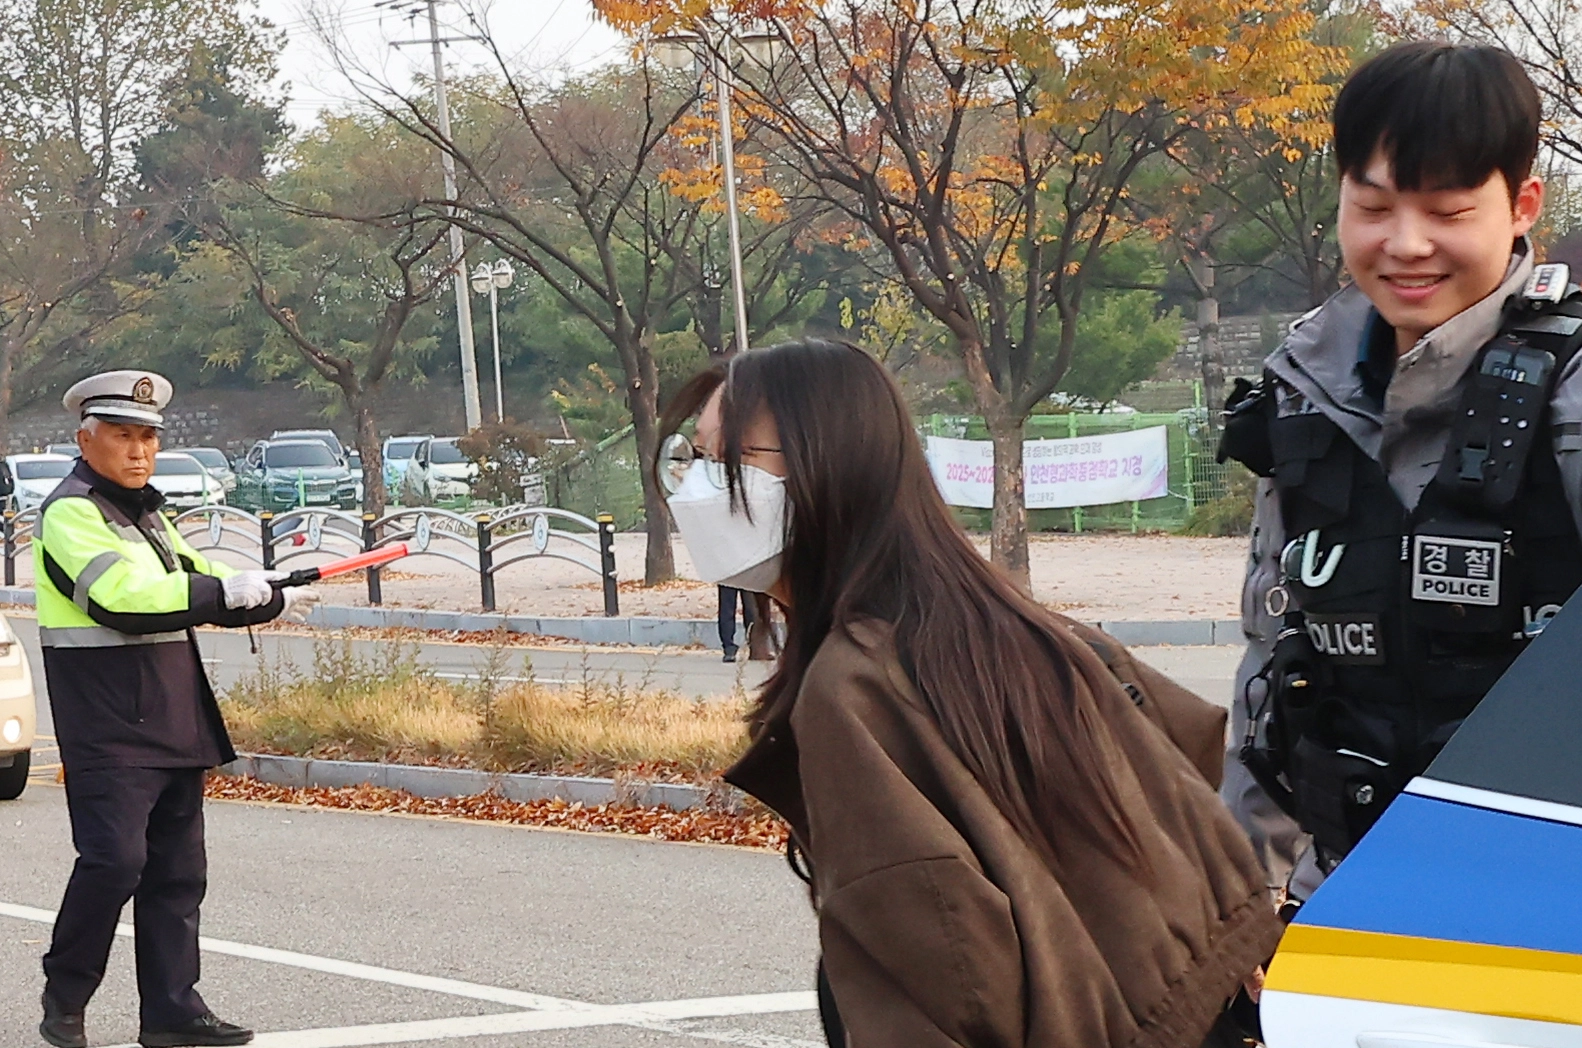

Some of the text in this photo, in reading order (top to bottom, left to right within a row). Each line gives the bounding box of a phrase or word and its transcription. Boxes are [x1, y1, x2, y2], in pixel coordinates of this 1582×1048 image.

[1121, 455, 1143, 477] 지정
[1422, 578, 1490, 598] POLICE
[1304, 619, 1377, 656] OLICE
